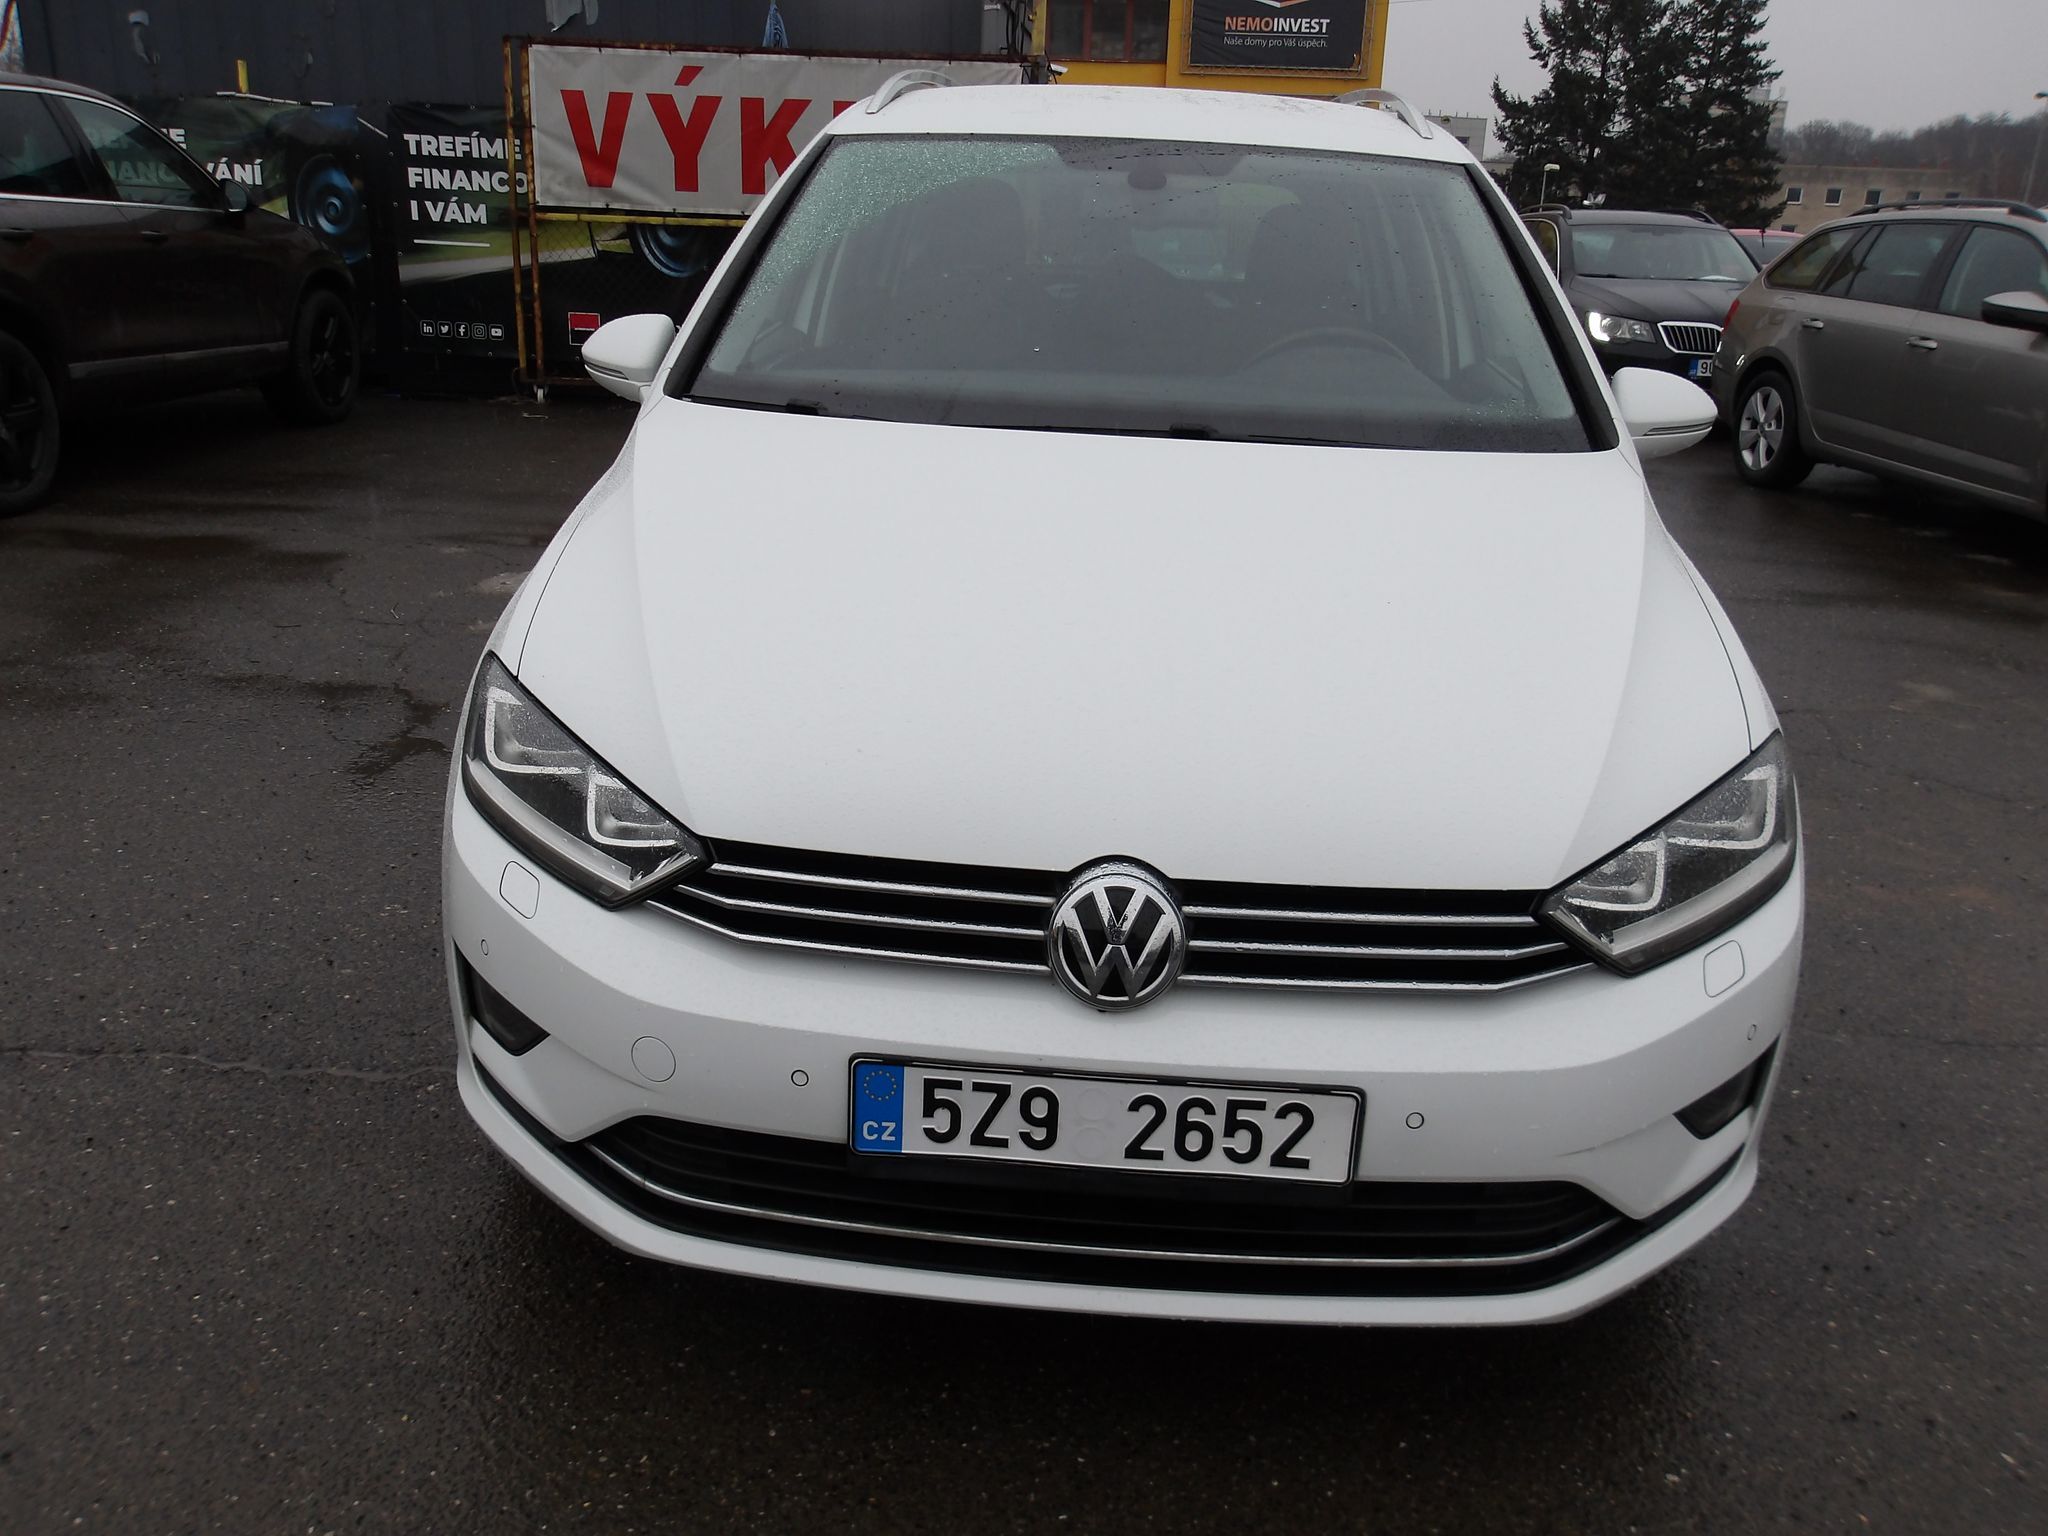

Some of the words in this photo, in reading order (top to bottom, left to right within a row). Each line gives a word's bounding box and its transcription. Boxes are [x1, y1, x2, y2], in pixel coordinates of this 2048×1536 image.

[1224, 16, 1331, 33] NEMOINVEST
[1223, 36, 1244, 46] Naše
[1244, 37, 1267, 47] domy
[1268, 39, 1283, 48] pro
[1283, 37, 1297, 47] Váš
[1297, 38, 1328, 49] úspěch.
[560, 65, 857, 195] VÝK
[403, 131, 522, 160] TREFÍME
[410, 200, 419, 220] I
[424, 197, 488, 224] VÁM
[861, 1120, 897, 1142] CZ
[921, 1075, 1061, 1151] 5Z9
[1123, 1093, 1316, 1171] 2652
